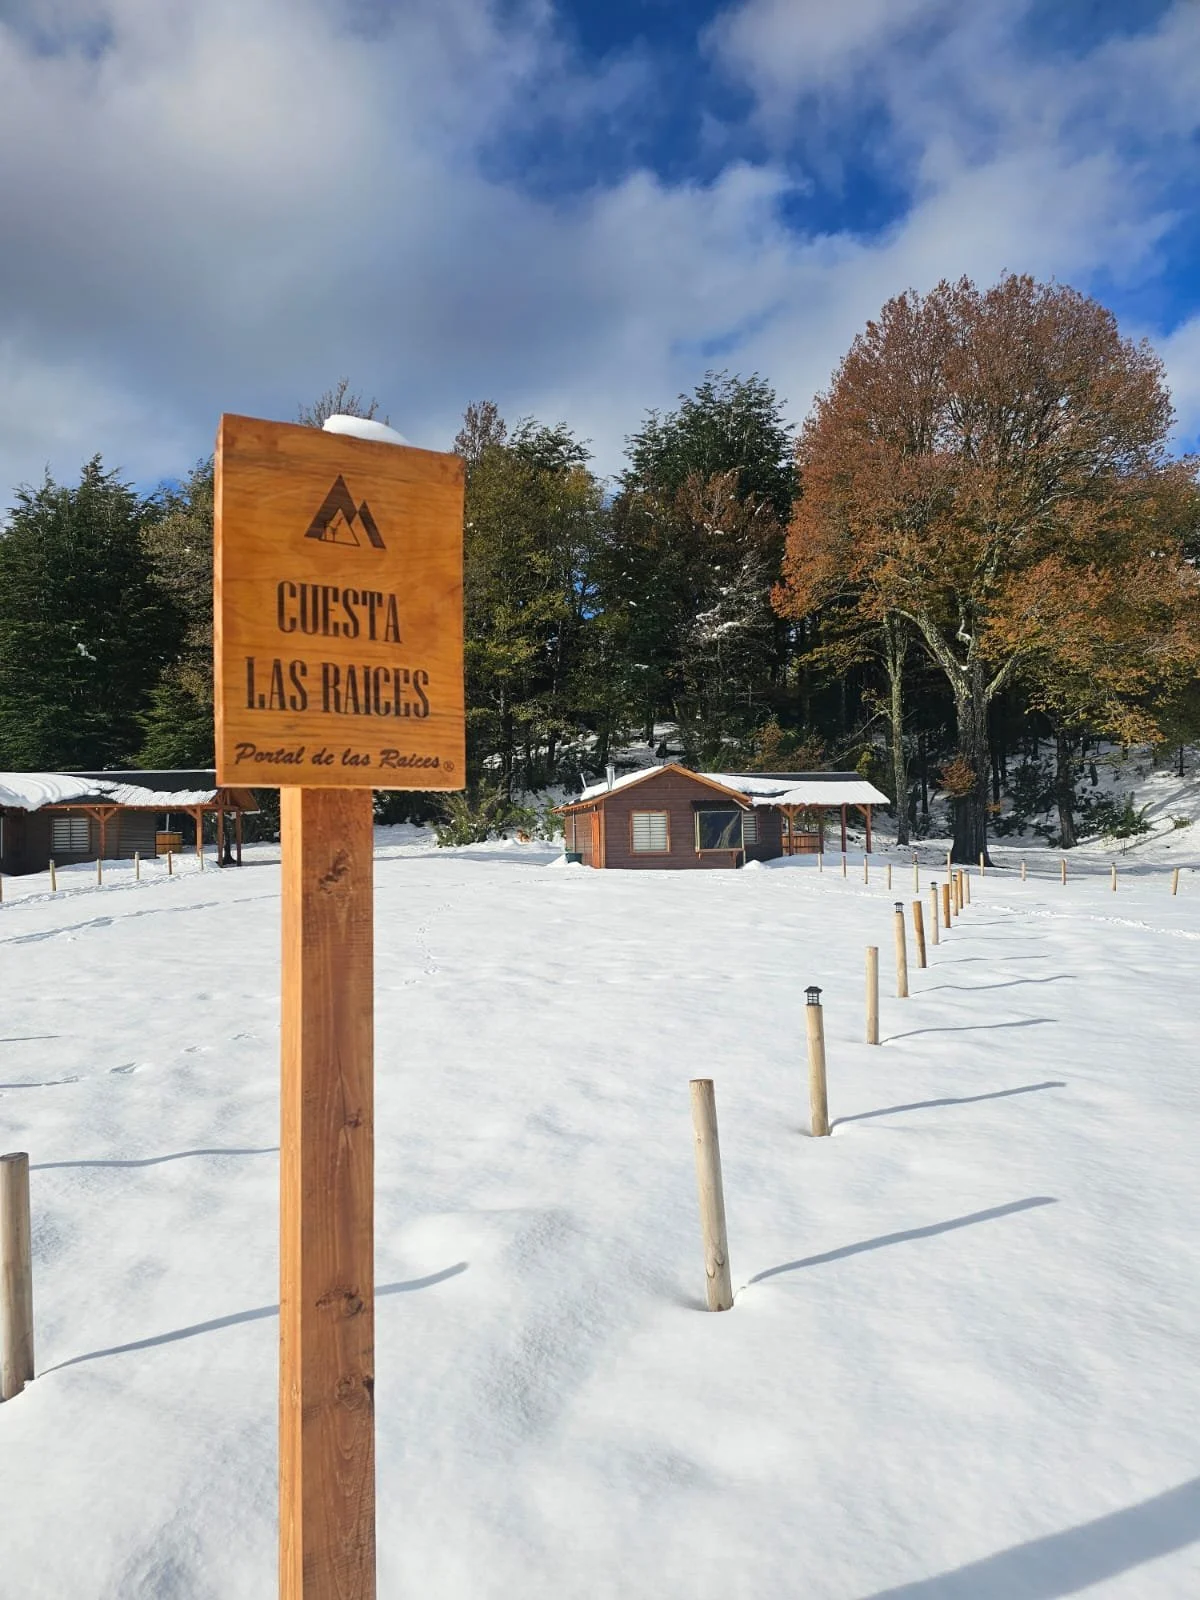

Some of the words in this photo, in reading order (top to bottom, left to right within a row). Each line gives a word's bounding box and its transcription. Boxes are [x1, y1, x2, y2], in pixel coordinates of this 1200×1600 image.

[277, 580, 402, 644] CUESTA
[244, 656, 308, 712] LAS
[321, 662, 430, 718] RAICES
[234, 742, 304, 765] Portal
[311, 747, 334, 766] de
[341, 748, 371, 767] las
